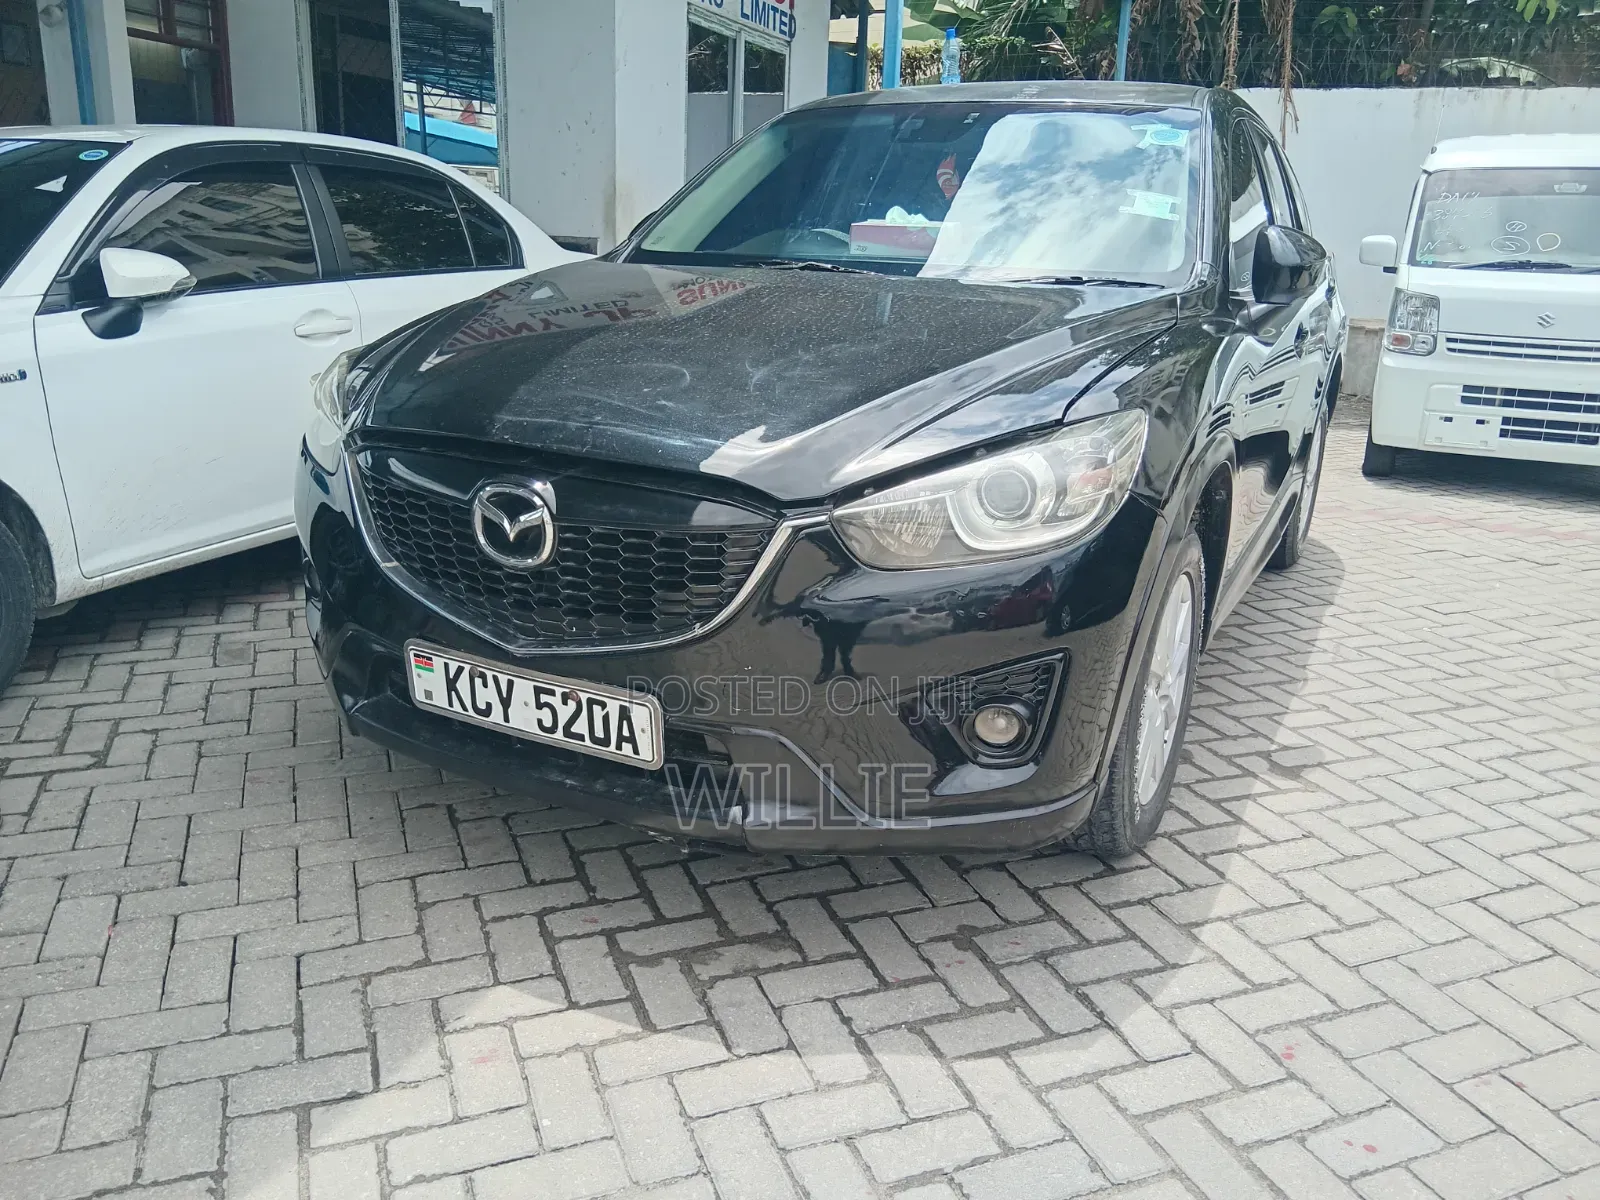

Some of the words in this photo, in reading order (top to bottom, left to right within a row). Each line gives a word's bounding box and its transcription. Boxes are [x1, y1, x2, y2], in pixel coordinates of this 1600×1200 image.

[740, 0, 796, 39] LIMITED
[443, 661, 515, 724] KCY
[533, 685, 640, 756] 520A
